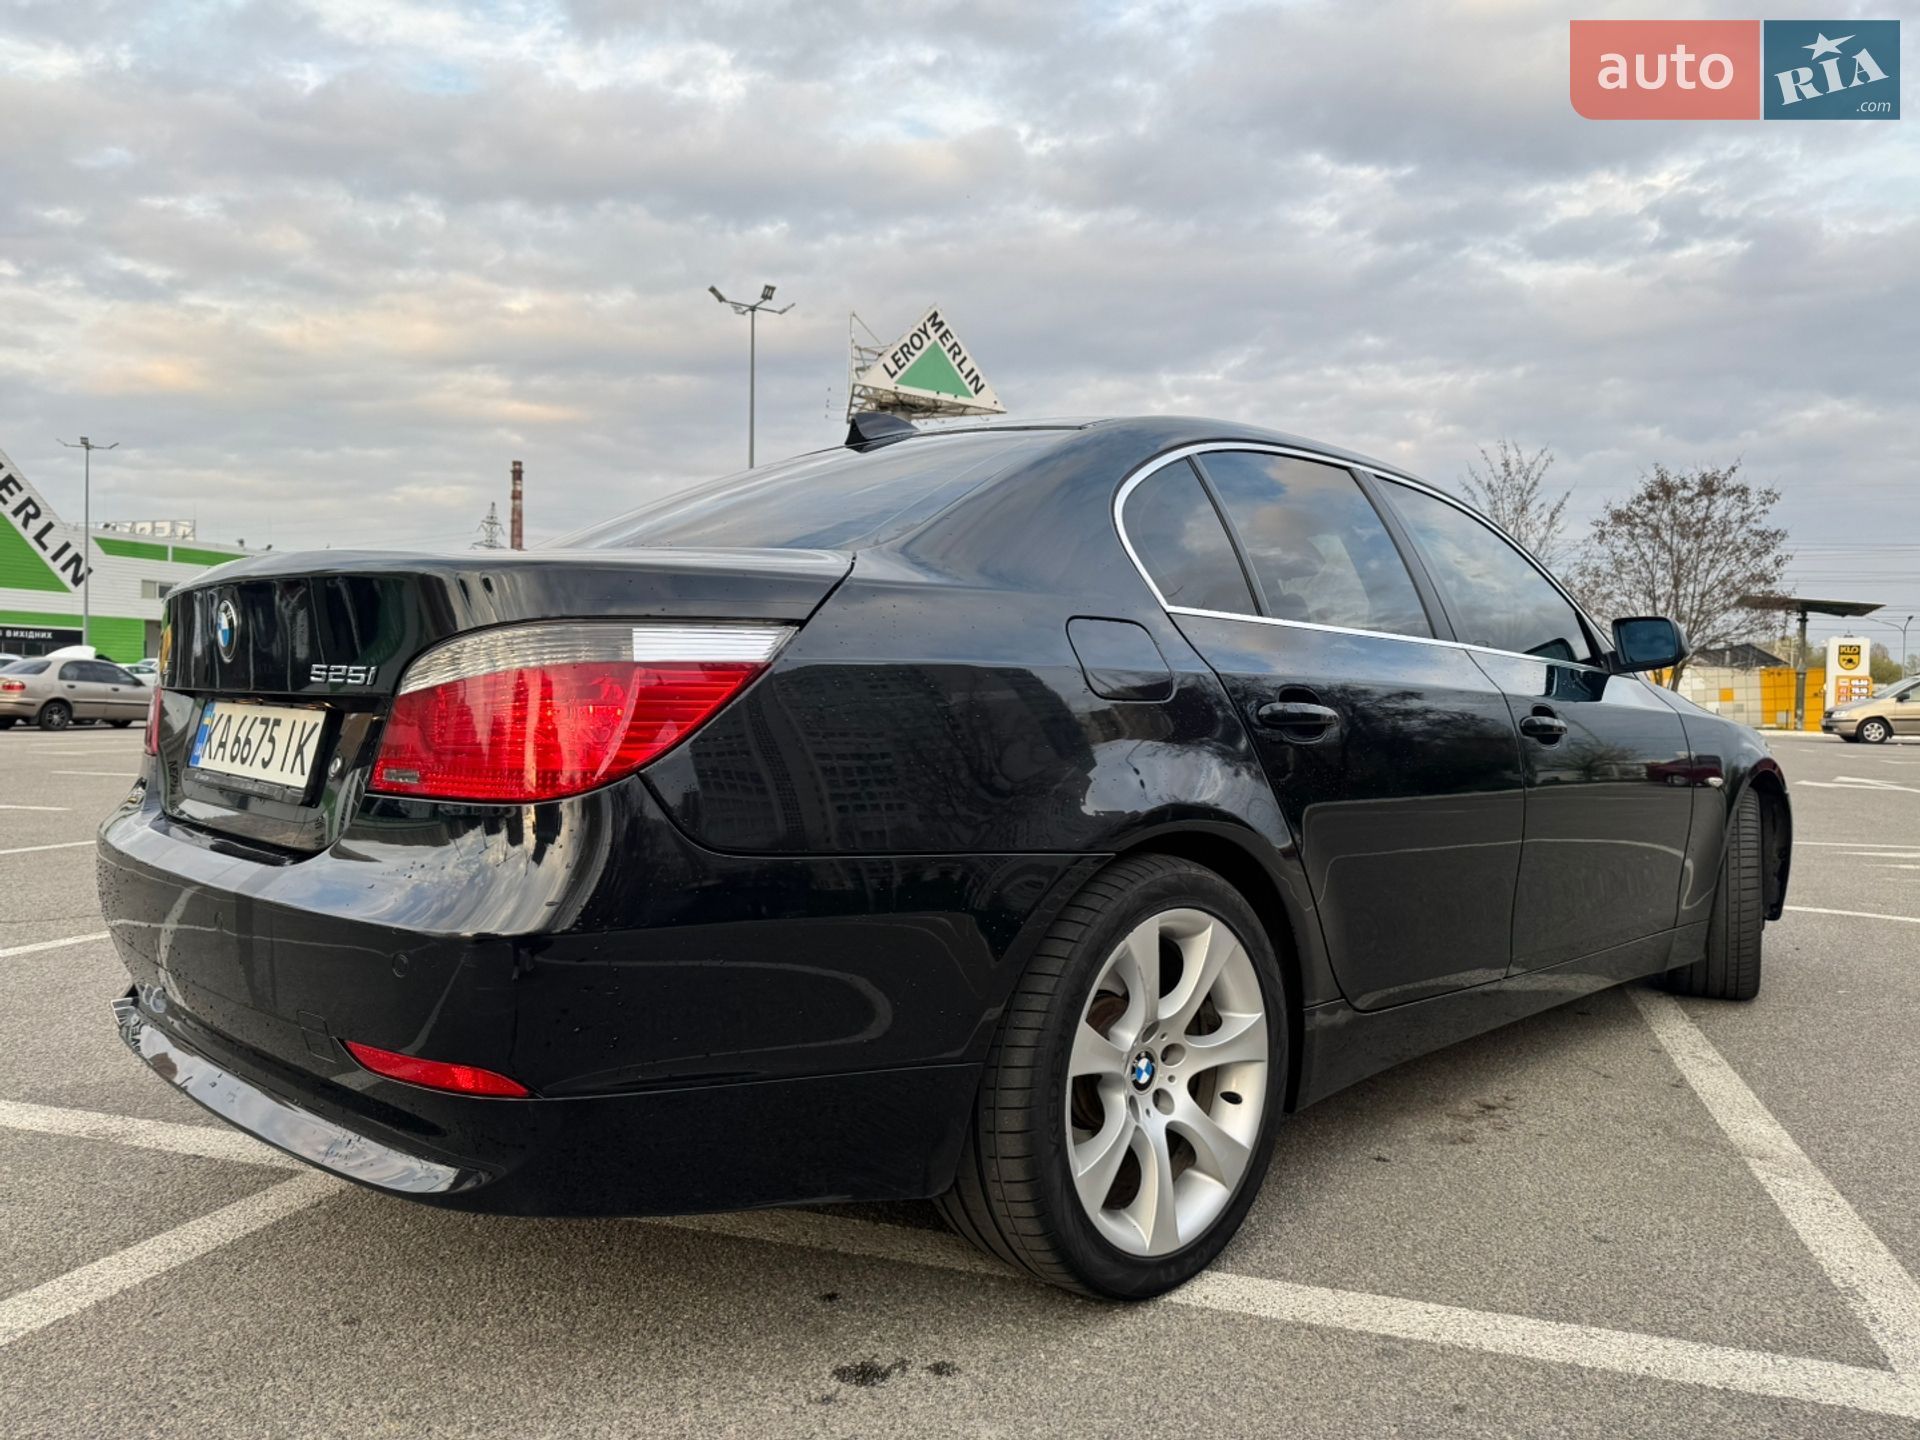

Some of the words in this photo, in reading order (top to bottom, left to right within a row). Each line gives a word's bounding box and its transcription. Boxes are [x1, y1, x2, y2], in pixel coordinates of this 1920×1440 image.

[882, 322, 932, 379] LEROY
[927, 310, 986, 396] MERLIN
[0, 462, 94, 588] ERLIN
[310, 663, 378, 686] 525i
